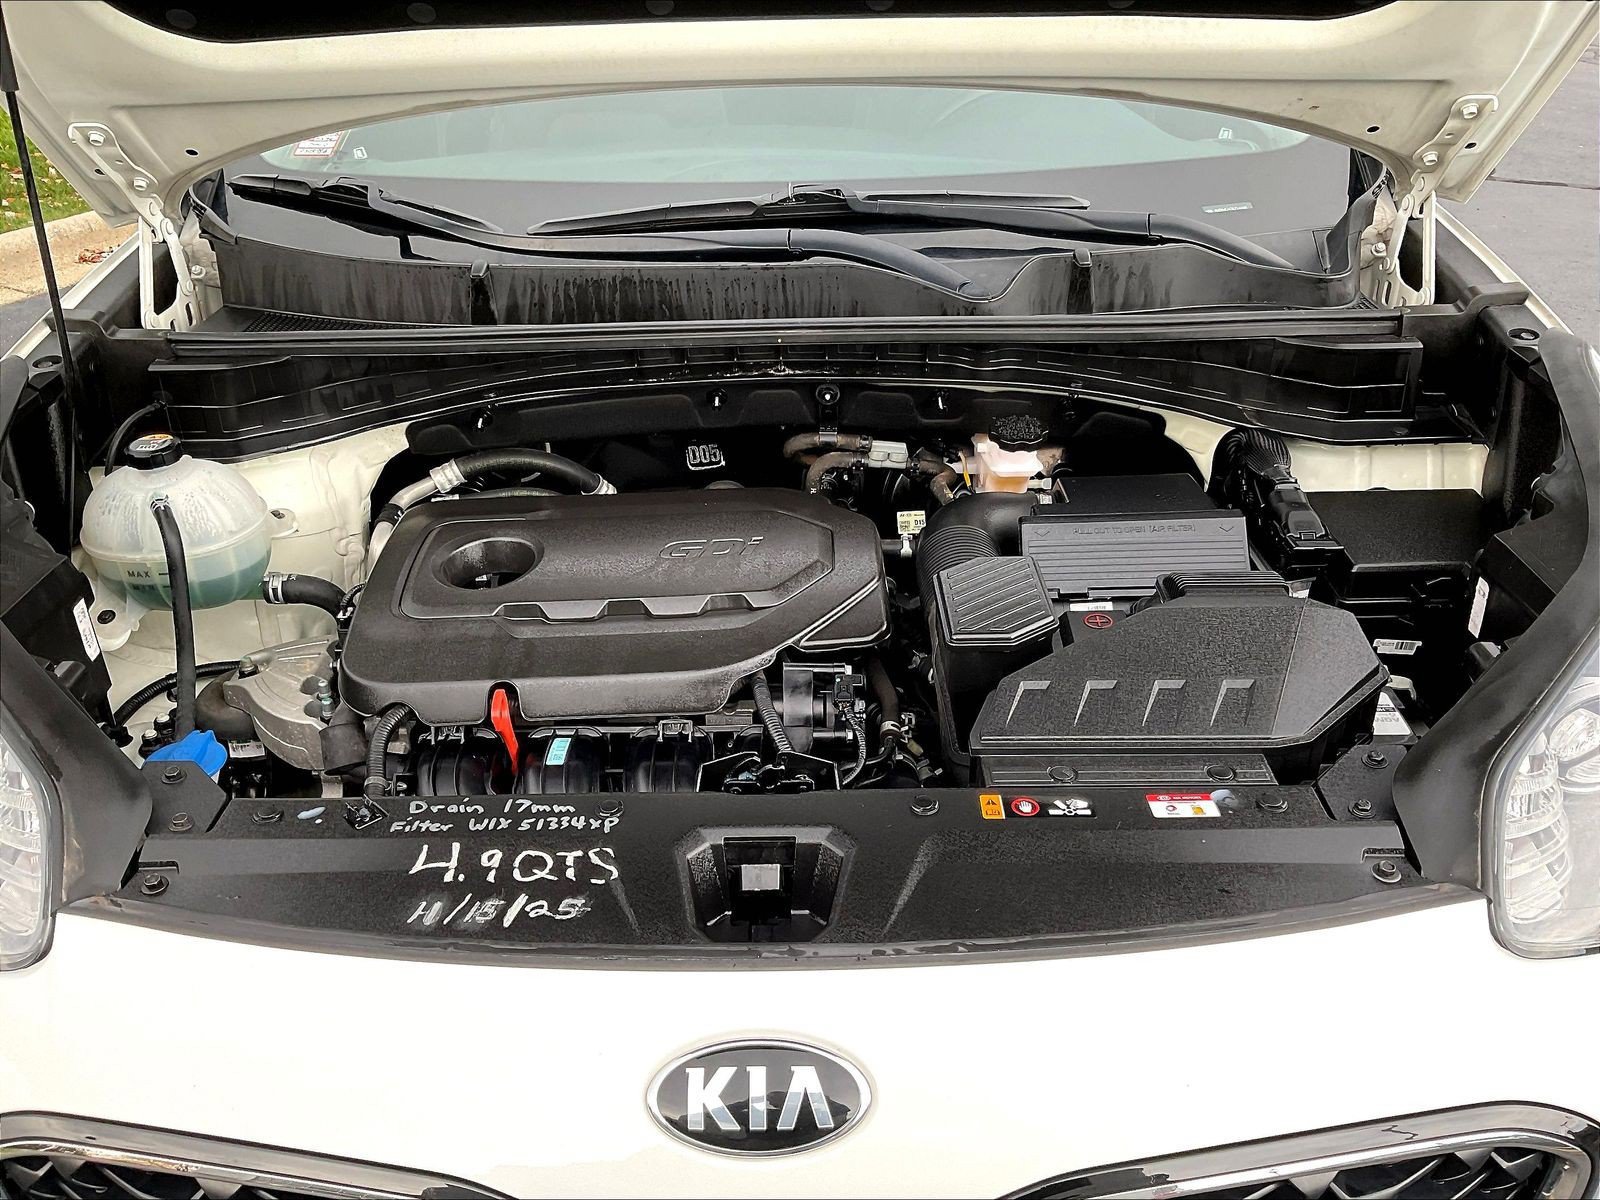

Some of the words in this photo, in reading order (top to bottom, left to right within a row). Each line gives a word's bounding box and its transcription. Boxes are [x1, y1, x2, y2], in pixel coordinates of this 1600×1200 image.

[1124, 526, 1146, 534] OPEN
[127, 570, 151, 578] MAX
[409, 797, 485, 814] Drain
[503, 798, 576, 814] 17mm
[389, 817, 454, 833] Filter
[468, 816, 513, 832] WIX
[685, 1065, 835, 1131] KIA
